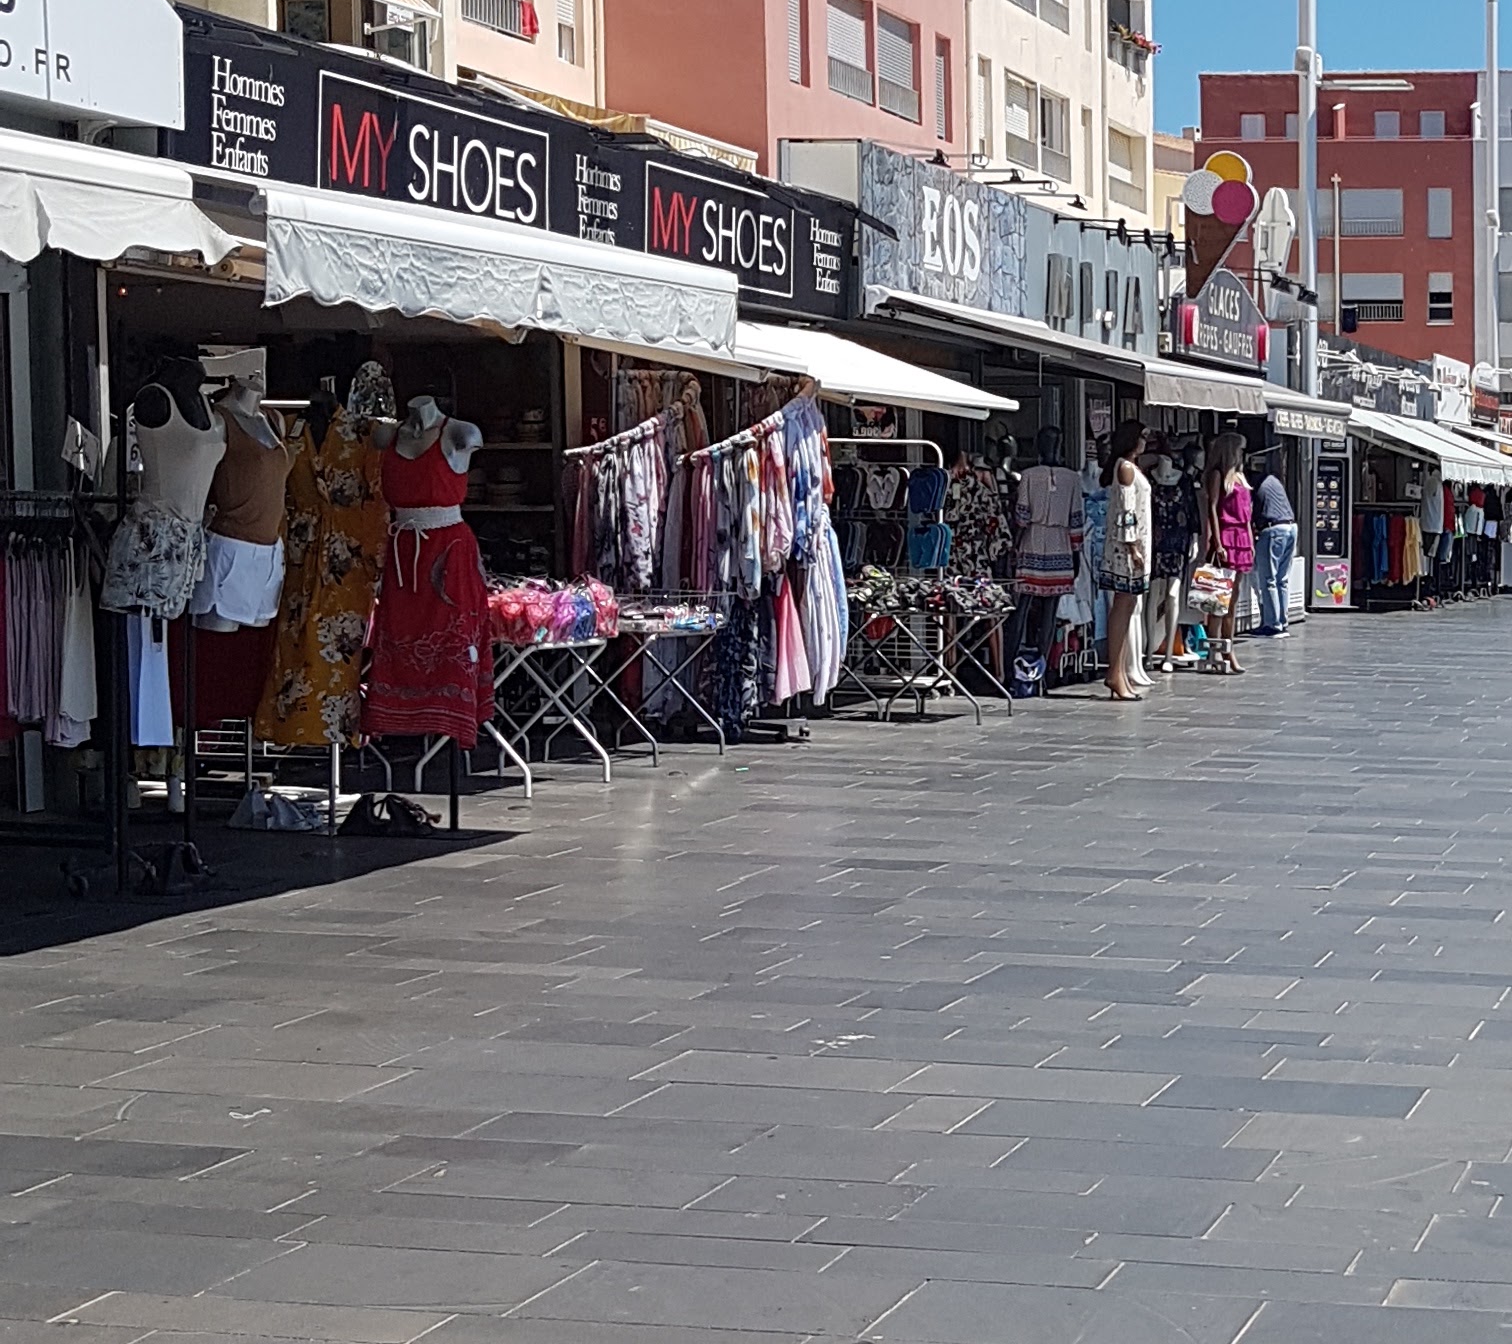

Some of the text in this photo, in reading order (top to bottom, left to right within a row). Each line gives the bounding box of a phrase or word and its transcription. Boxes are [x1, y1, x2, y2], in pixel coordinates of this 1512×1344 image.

[211, 54, 286, 108] Hommes
[210, 92, 278, 142] Femmes
[210, 130, 270, 177] Enfants
[330, 103, 538, 224] MY SHOES
[576, 184, 619, 220] Femmes
[653, 186, 787, 277] MY SHOES
[921, 185, 982, 282] EOS
[1208, 282, 1240, 322] GLACES
[1223, 328, 1254, 360] GAUFRES
